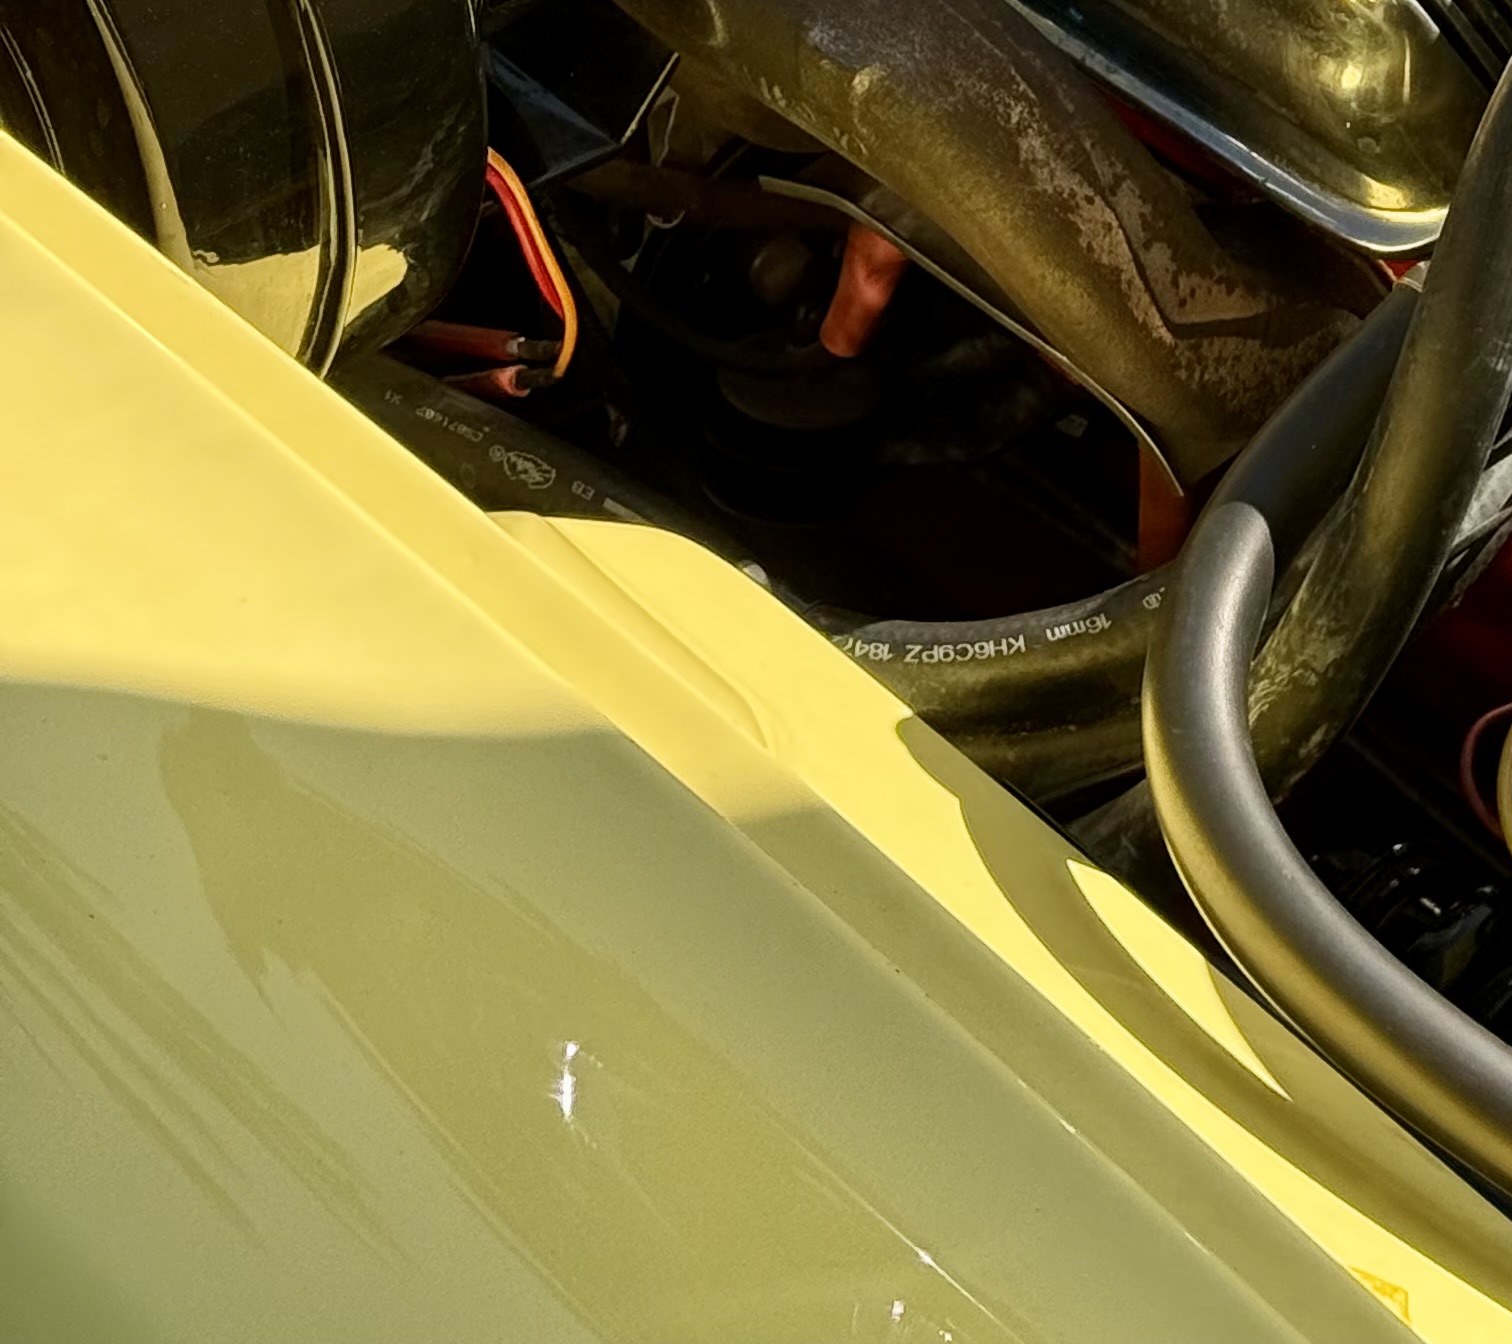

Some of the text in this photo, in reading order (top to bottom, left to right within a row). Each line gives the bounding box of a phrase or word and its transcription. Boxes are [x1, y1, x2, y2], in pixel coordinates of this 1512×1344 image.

[841, 611, 1114, 664] 16mm KH6C9PZ 1847
